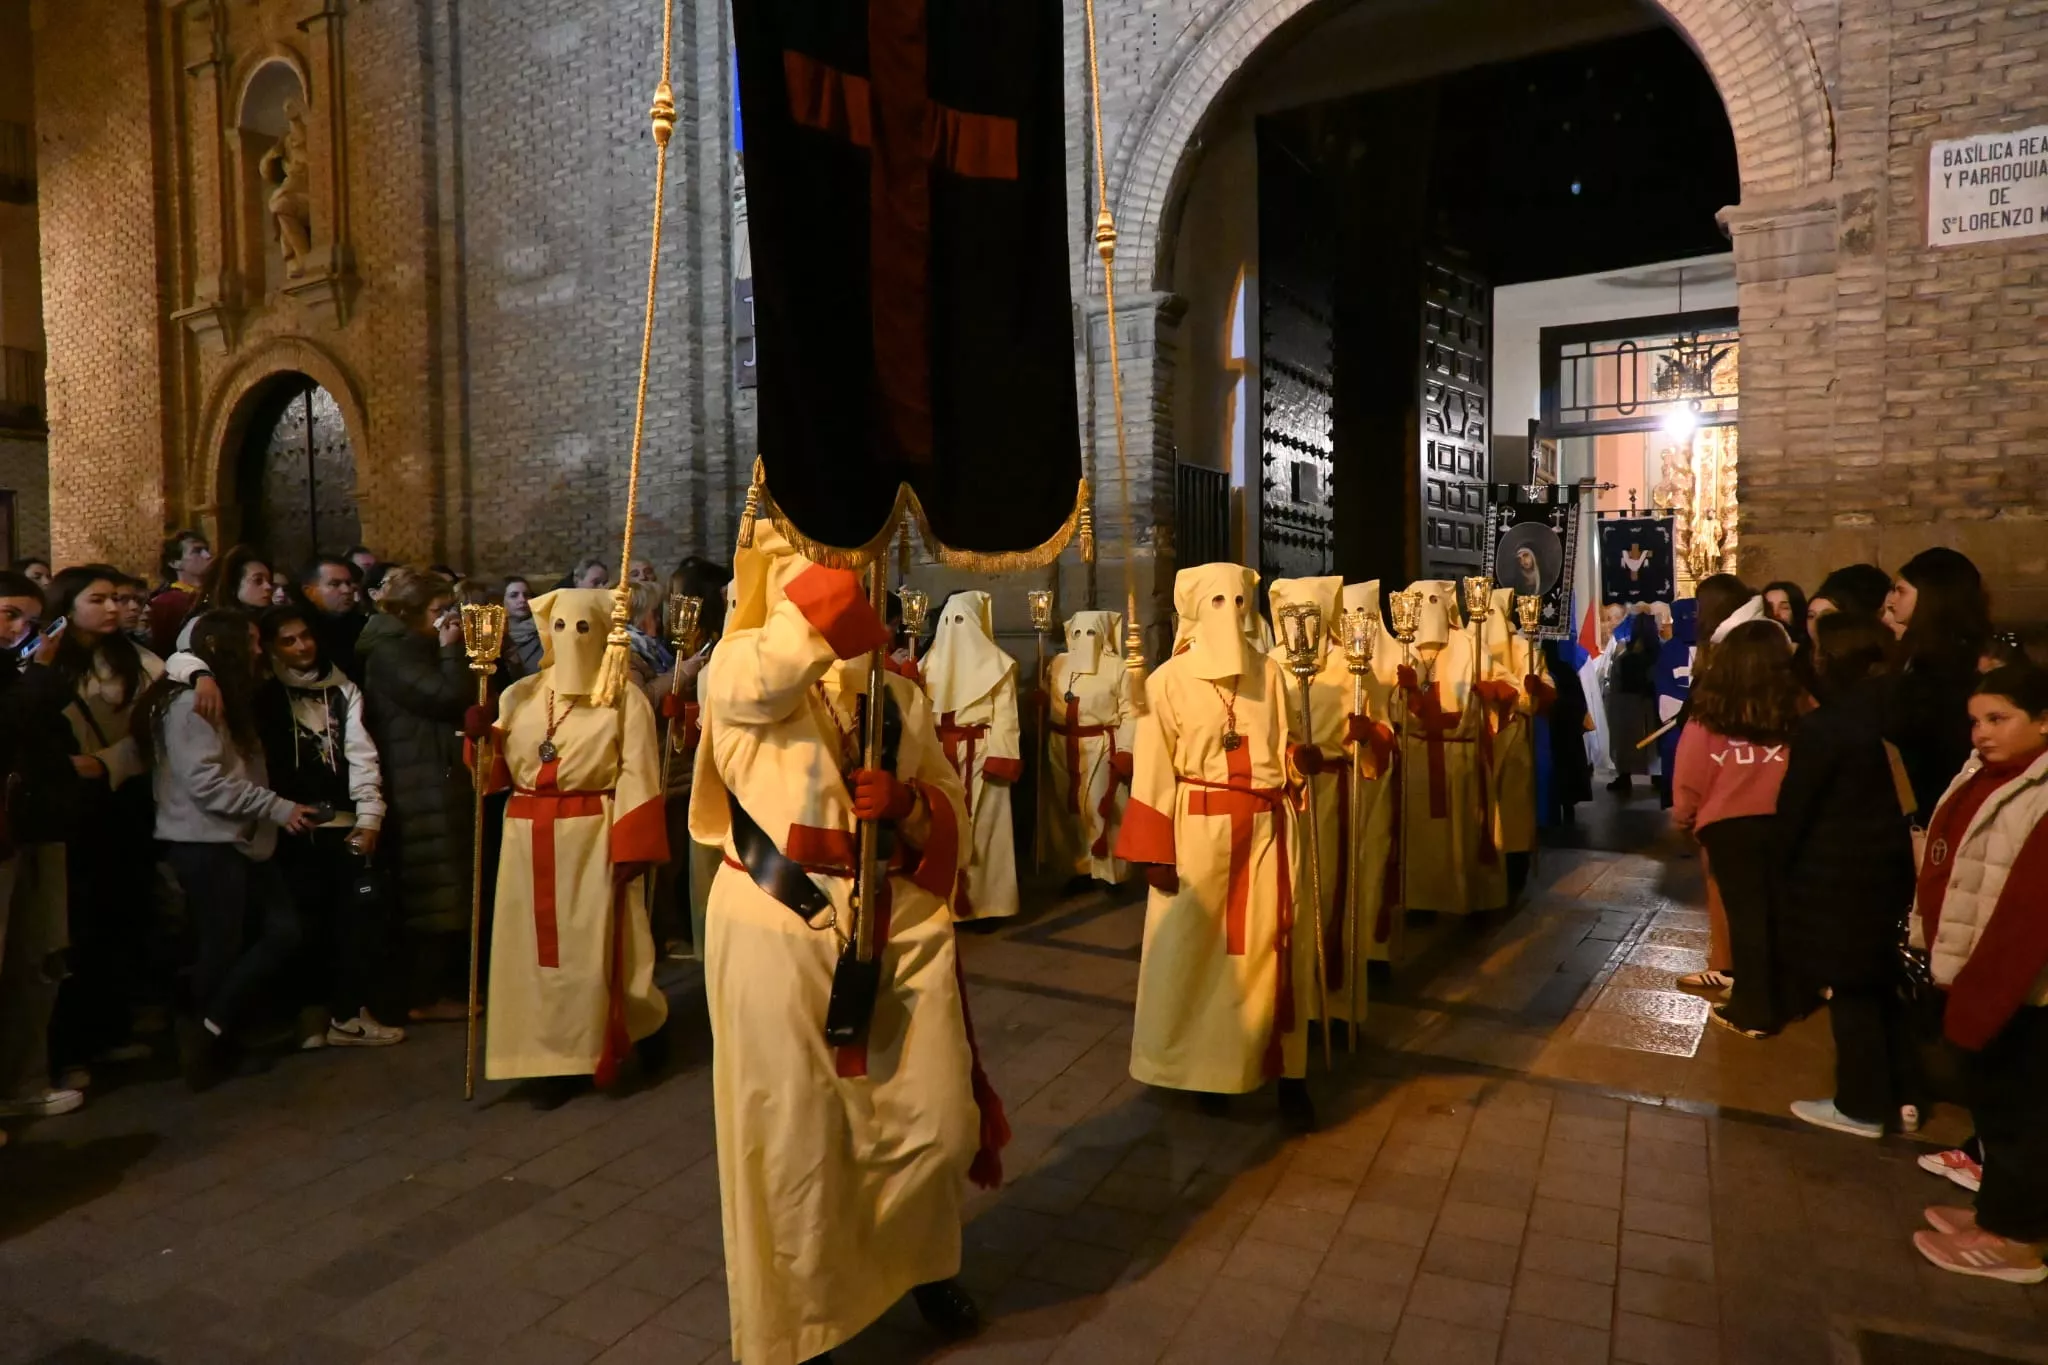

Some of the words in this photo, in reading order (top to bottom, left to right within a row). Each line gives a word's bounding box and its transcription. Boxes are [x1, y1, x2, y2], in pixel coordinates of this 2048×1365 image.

[2019, 136, 2048, 156] REA
[1944, 172, 1952, 189] Y
[1959, 159, 2048, 188] PARROQUIA
[1989, 187, 2011, 206] DE
[1958, 207, 2033, 233] LORENZO
